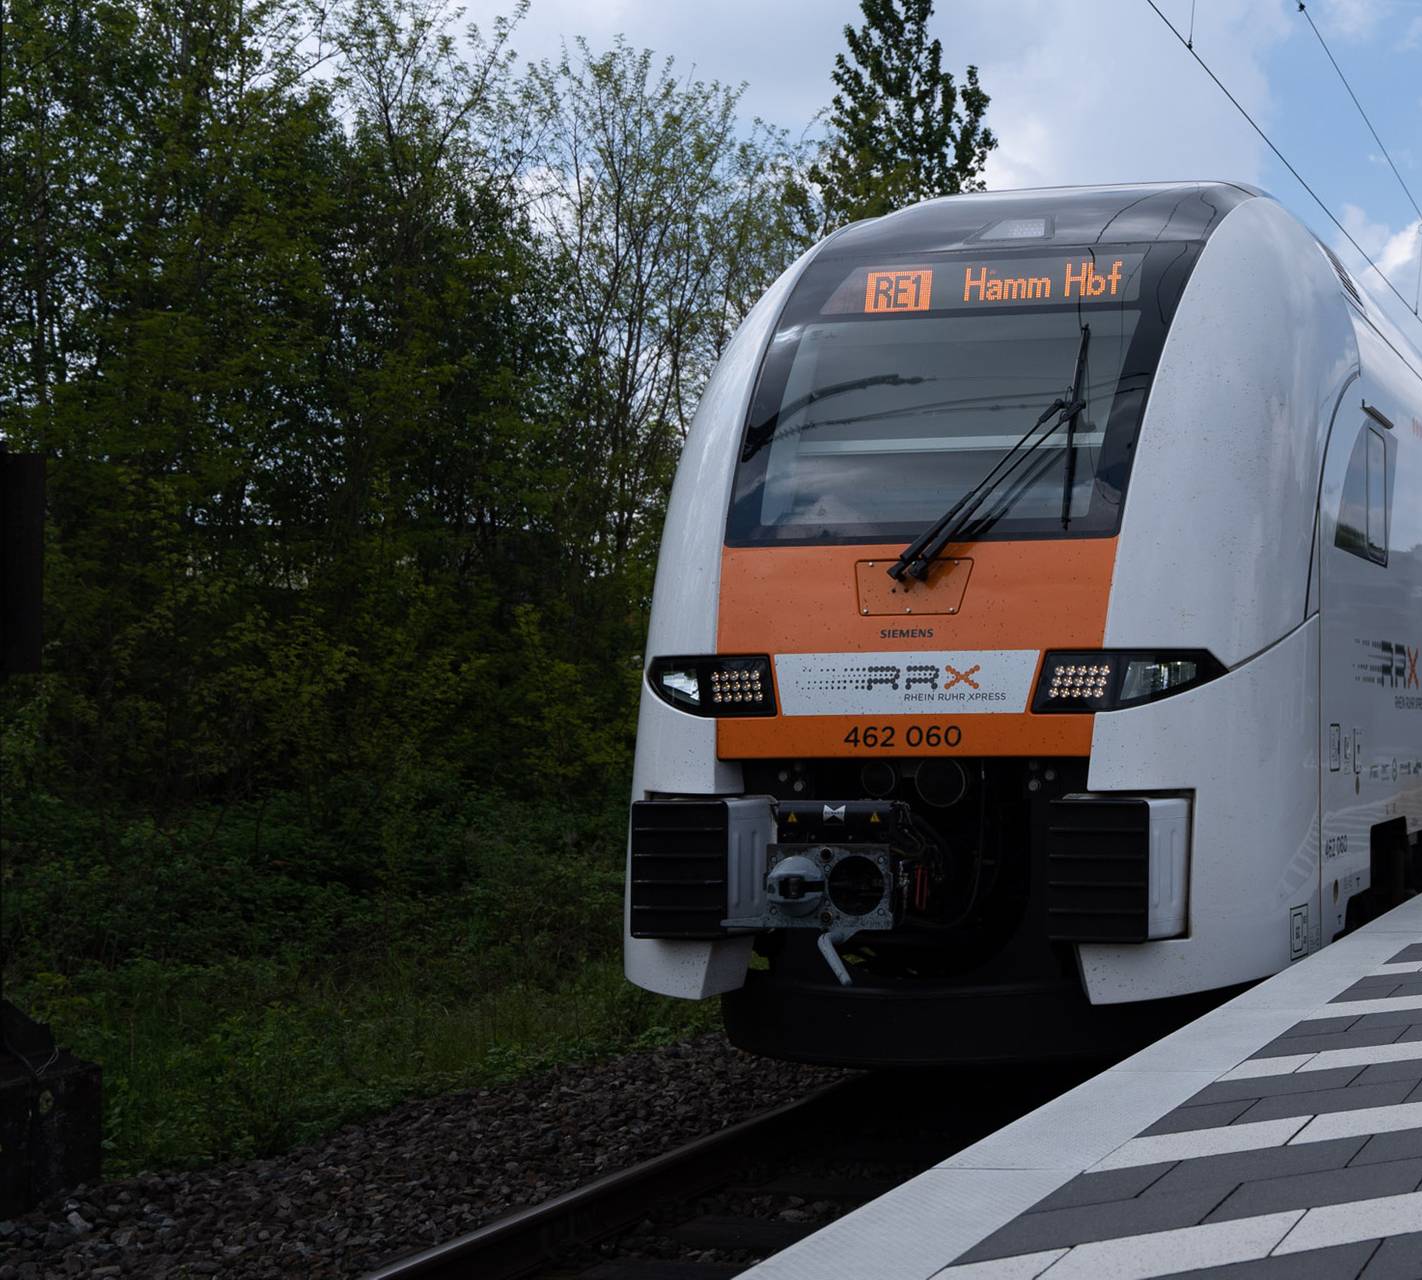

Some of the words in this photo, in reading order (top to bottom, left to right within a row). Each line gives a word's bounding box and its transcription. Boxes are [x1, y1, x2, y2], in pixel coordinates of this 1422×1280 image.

[873, 273, 923, 310] RE1
[963, 266, 1051, 301] Hamm
[1064, 260, 1123, 297] Hbf
[879, 628, 934, 639] SIEMENS
[904, 693, 935, 702] RHEIN
[938, 692, 966, 701] RUHR
[968, 692, 1007, 701] XPRESS
[844, 726, 895, 748] 462
[905, 725, 963, 748] 060
